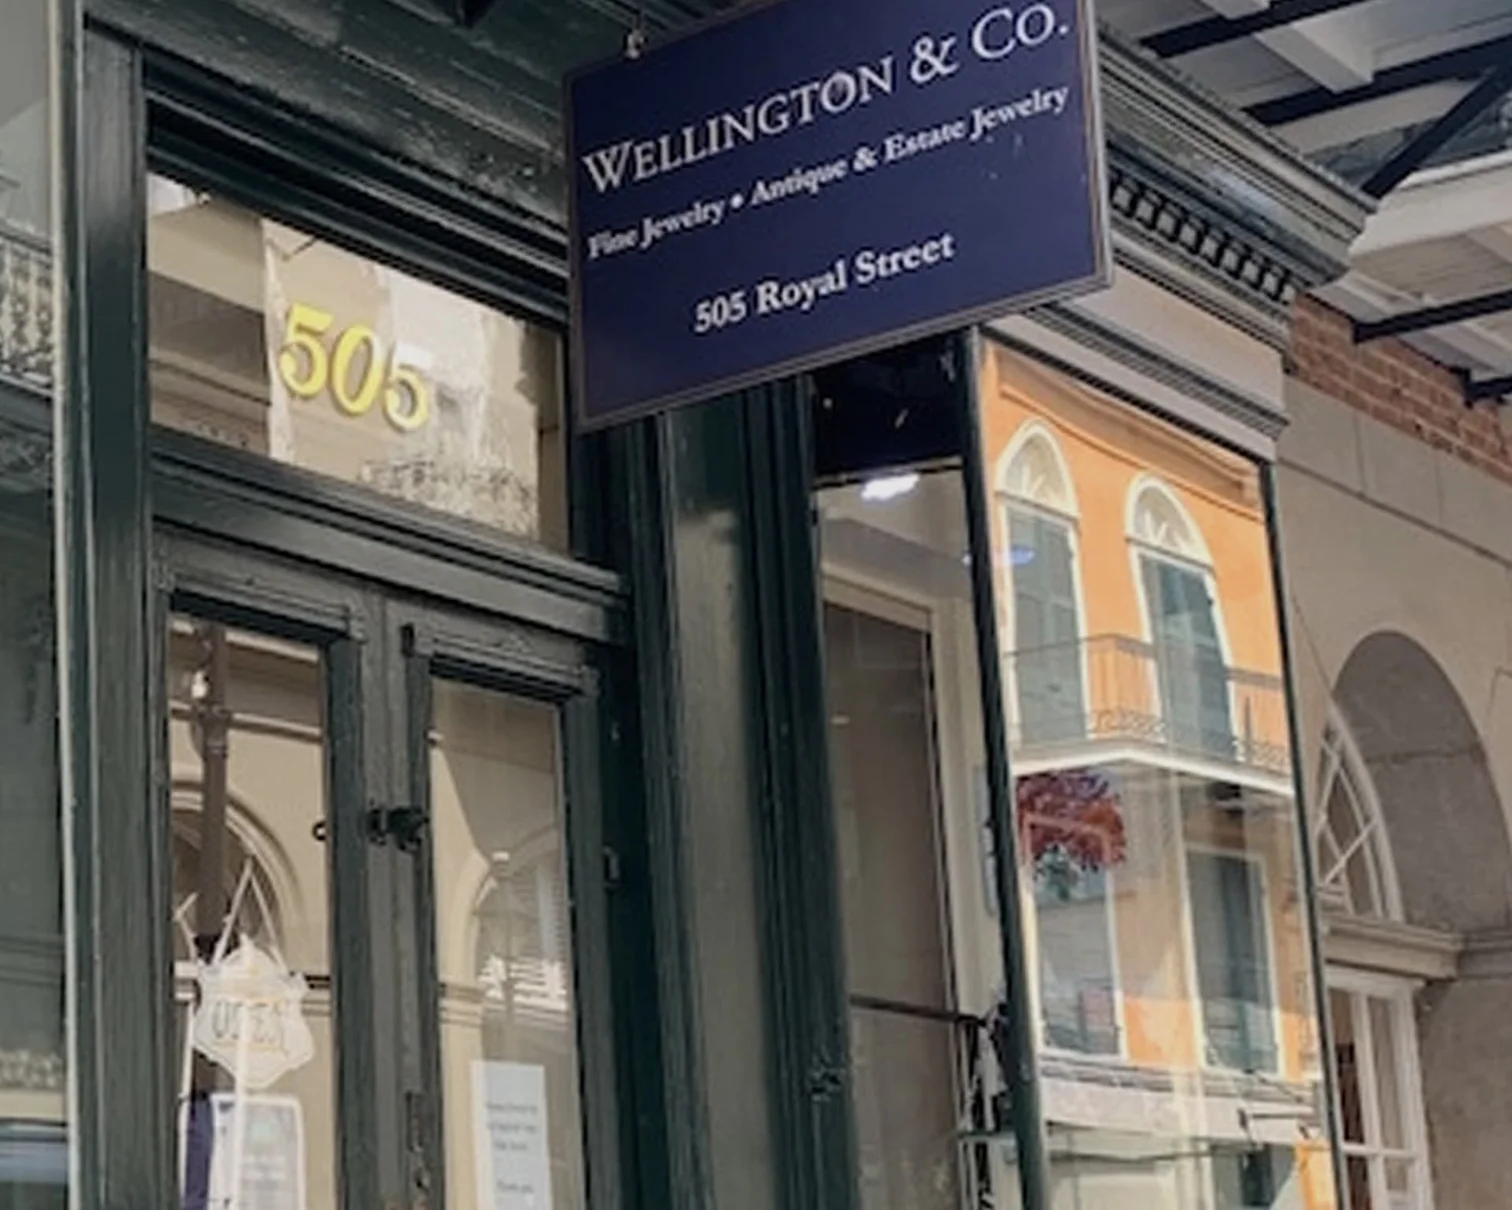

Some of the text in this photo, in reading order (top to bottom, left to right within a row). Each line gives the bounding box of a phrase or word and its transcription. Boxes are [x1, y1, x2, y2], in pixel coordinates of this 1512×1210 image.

[582, 56, 896, 192] WELLINGTON
[909, 36, 959, 84] &
[589, 86, 1069, 259] Fine Jewelry Antique & Estate Jewelry
[694, 233, 956, 334] 505 Royal Street
[278, 302, 430, 432] 505
